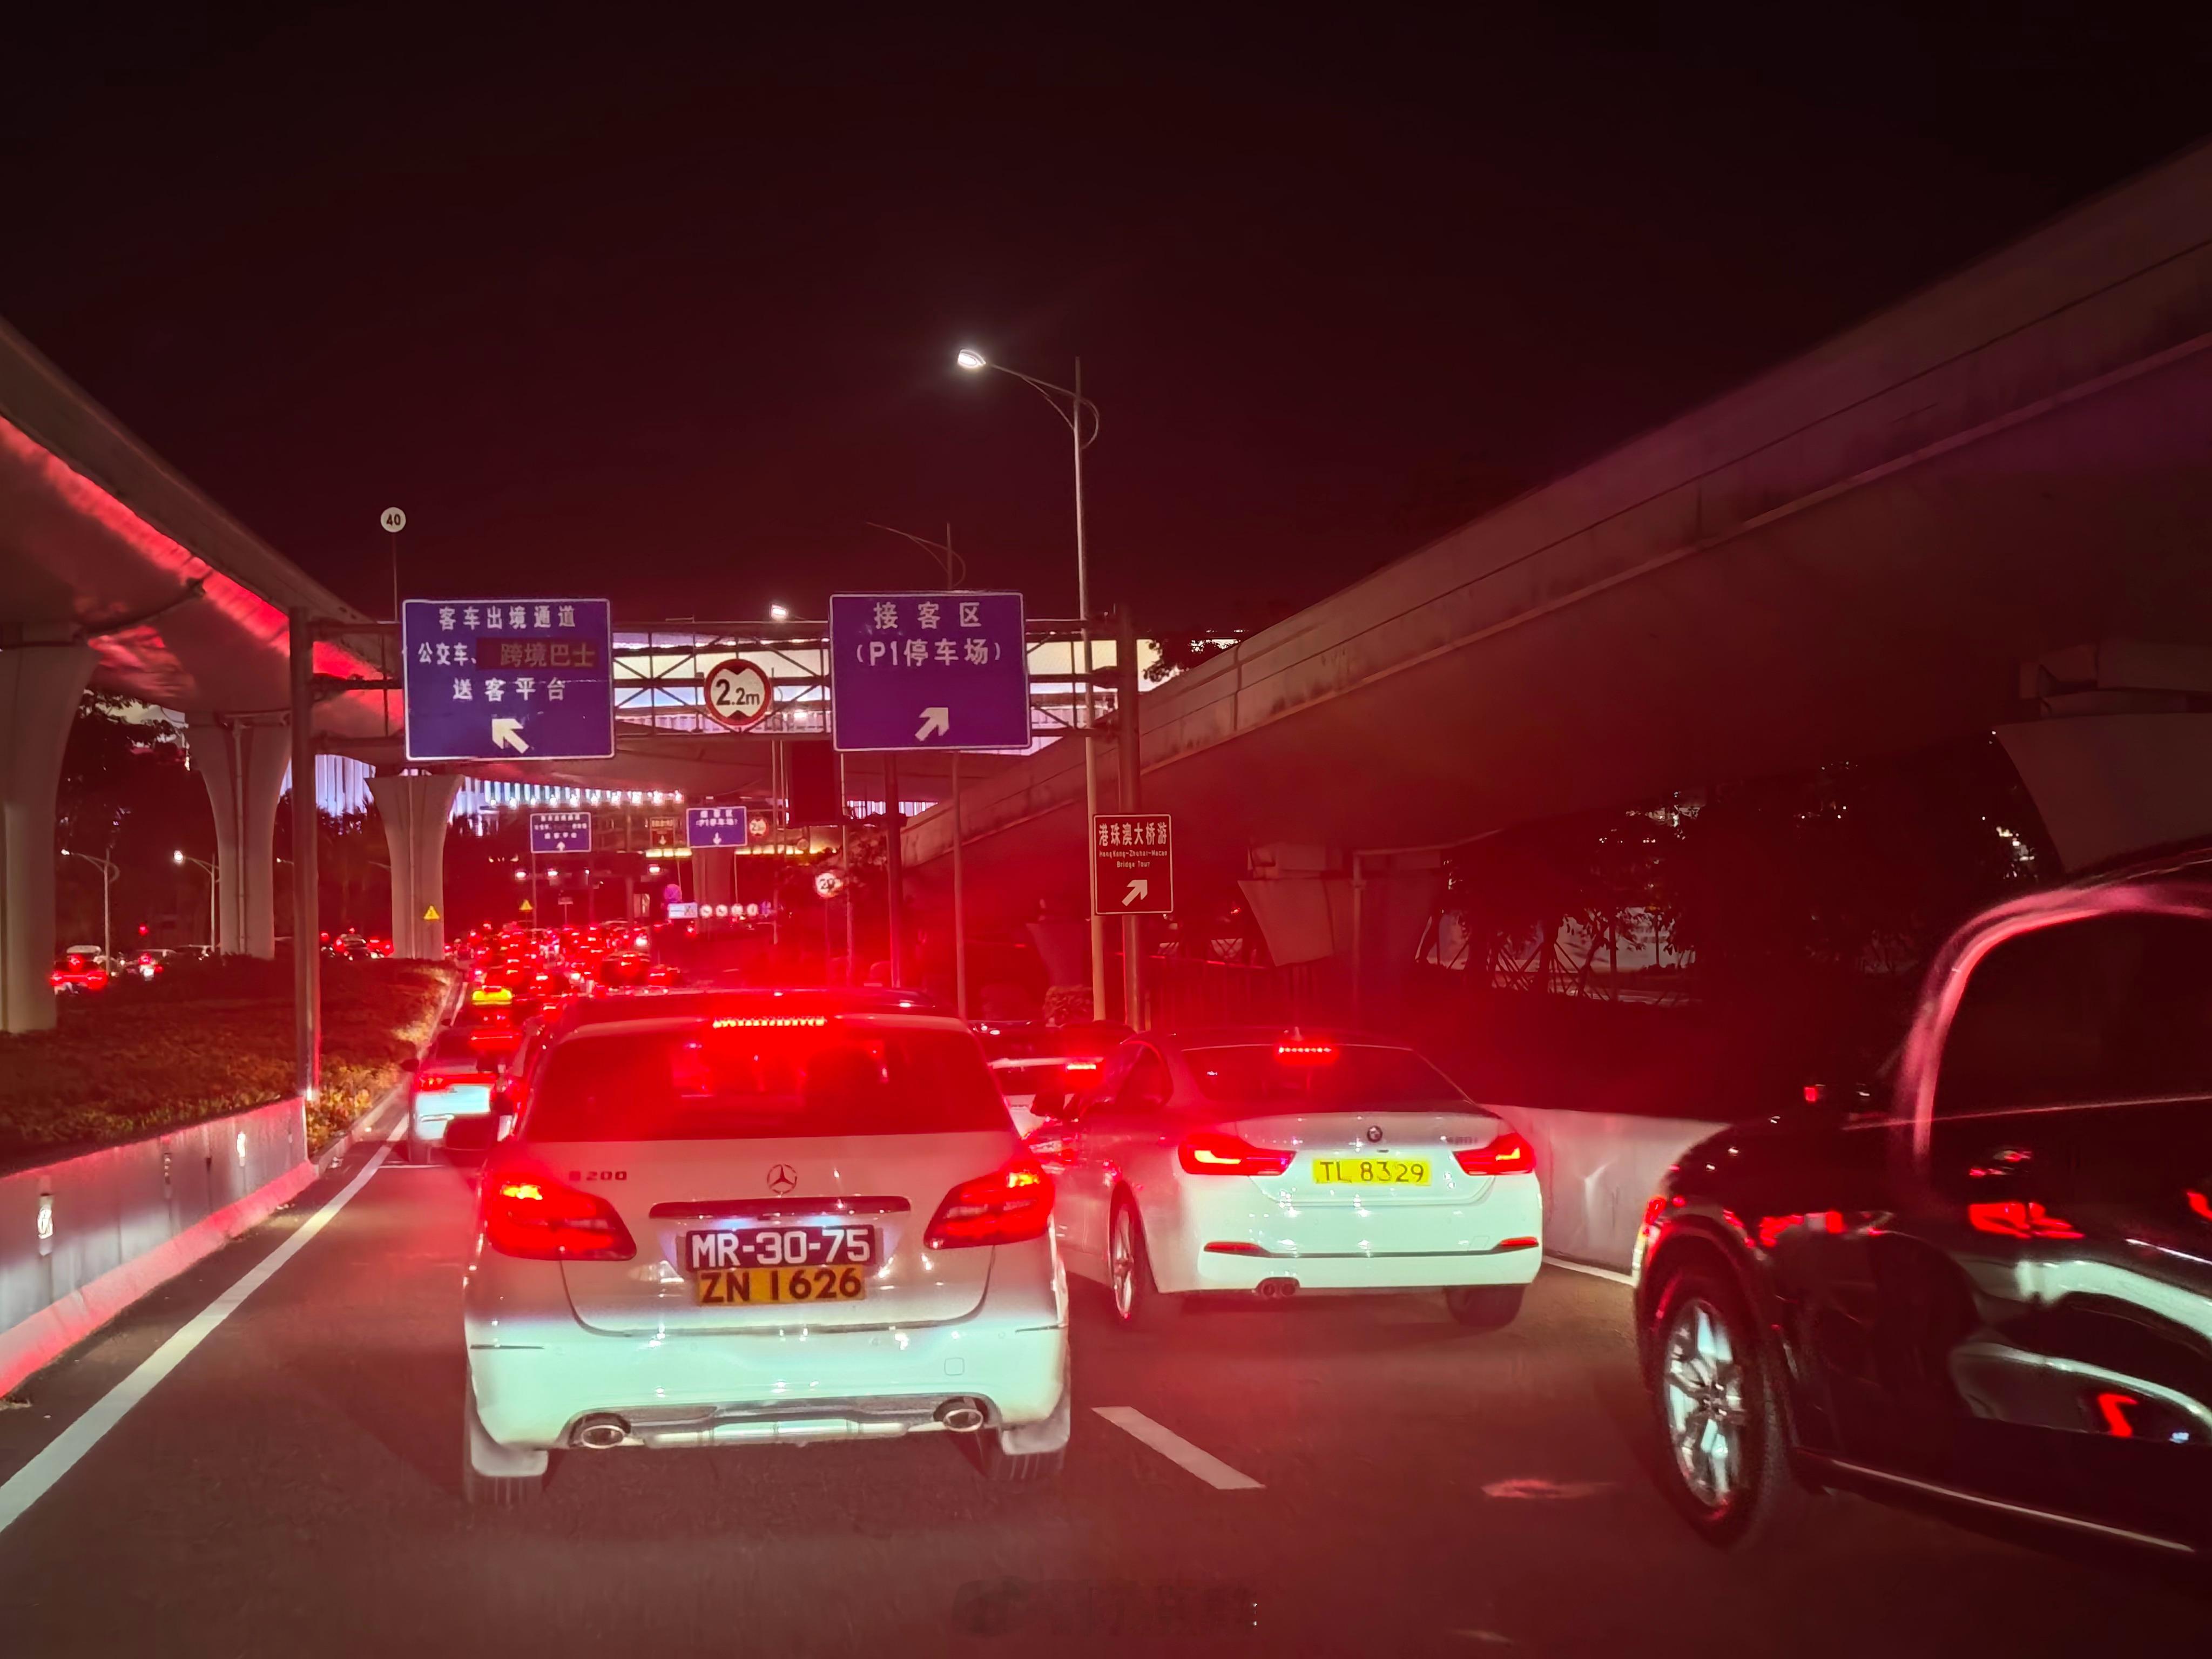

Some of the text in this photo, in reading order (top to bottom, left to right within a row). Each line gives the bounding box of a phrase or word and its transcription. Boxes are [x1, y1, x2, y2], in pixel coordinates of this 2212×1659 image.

[386, 514, 401, 526] 40
[439, 605, 576, 631] 客车出境通道
[873, 602, 982, 630] 接客区
[501, 643, 595, 668] 跨境巴士
[453, 677, 566, 702] 送客平台
[715, 678, 760, 706] 2.2m
[1099, 821, 1167, 846] 港珠澳大桥游
[1117, 861, 1135, 869] Bridge
[1320, 1161, 1424, 1183] TL 8329
[692, 1229, 870, 1268] MR-30-75
[702, 1267, 862, 1303] ZN 1626
